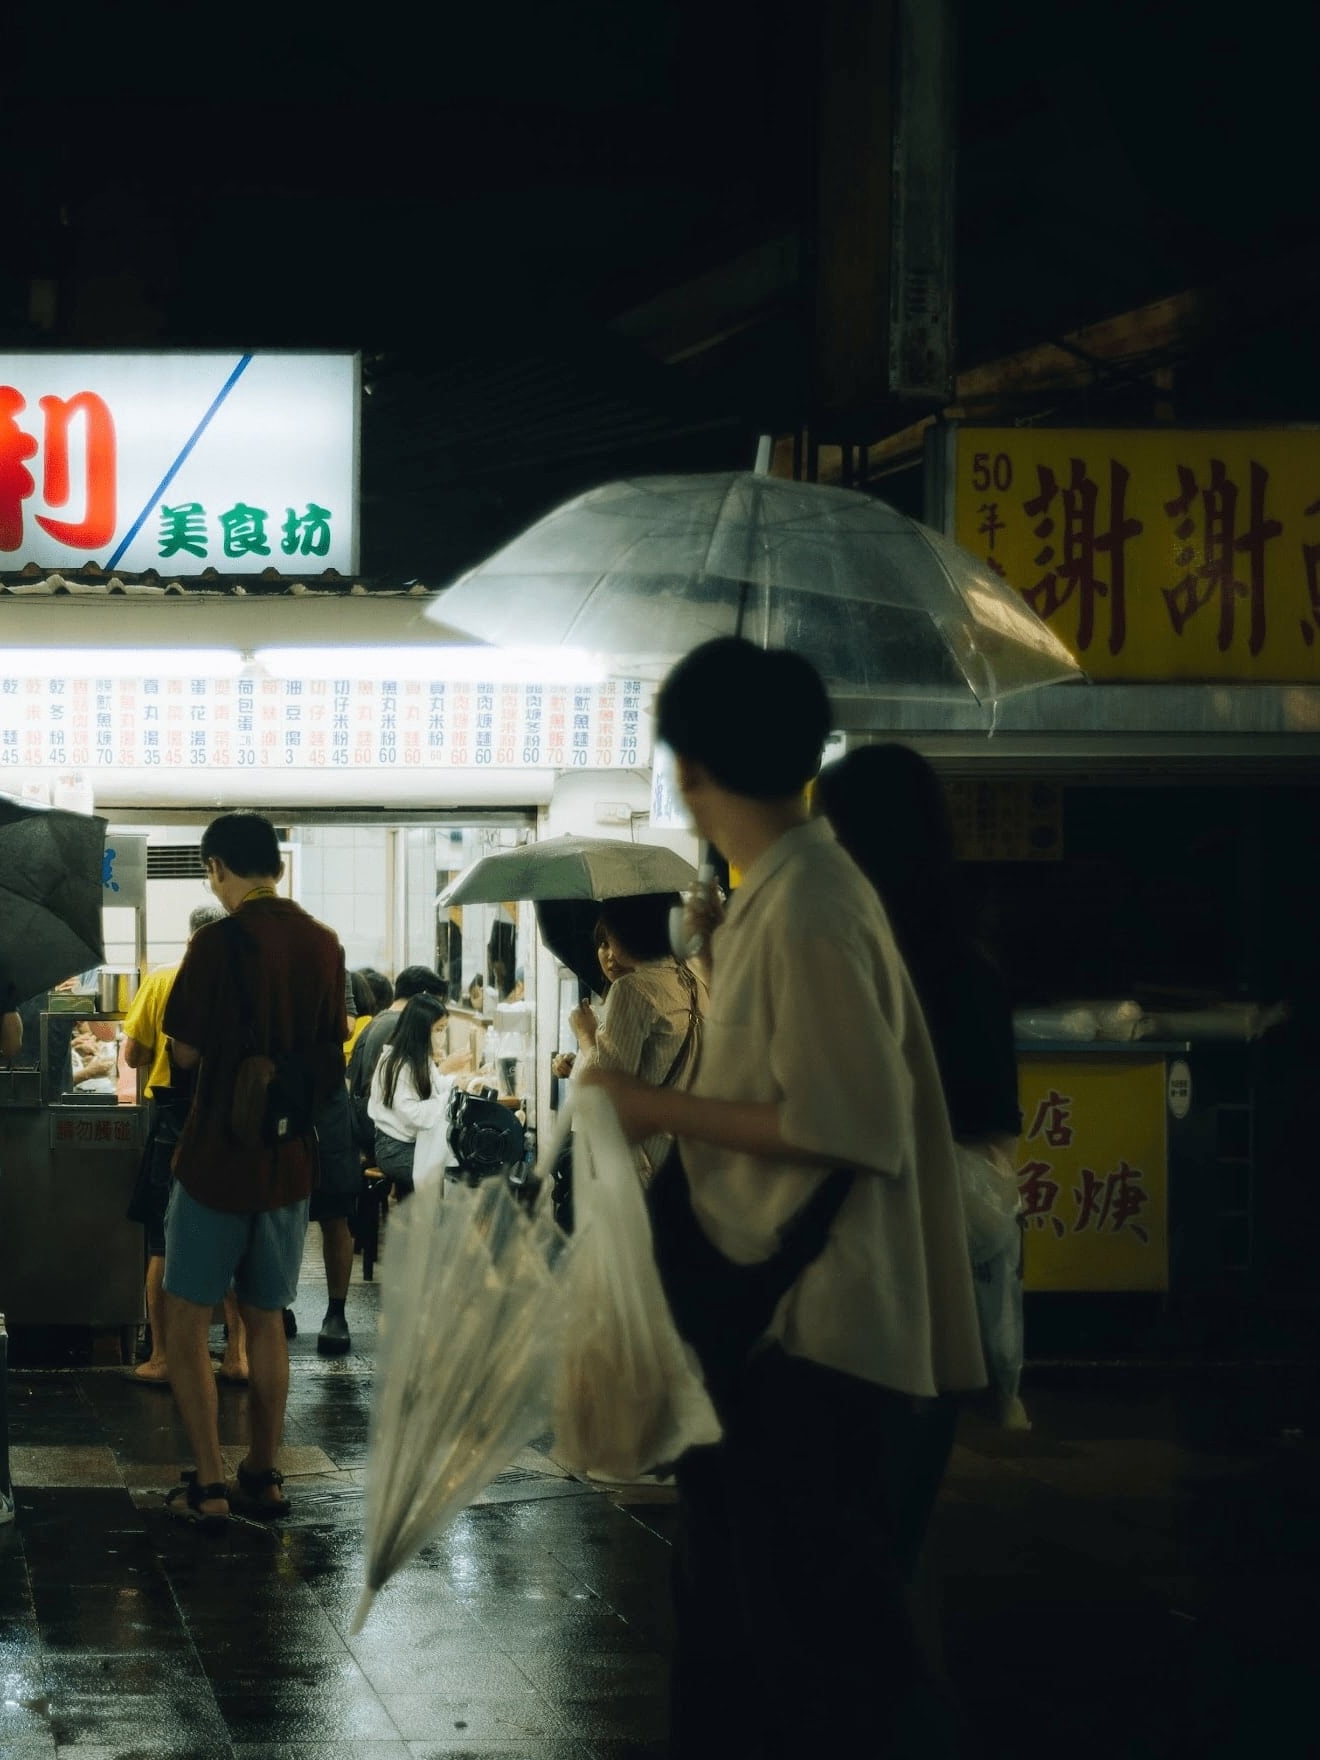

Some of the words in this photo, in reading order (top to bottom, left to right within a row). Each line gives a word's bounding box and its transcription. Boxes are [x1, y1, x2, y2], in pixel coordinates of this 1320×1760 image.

[158, 502, 332, 559] 美食坊
[1021, 457, 1320, 656] 謝謝
[49, 679, 65, 745] 乾冬粉
[1, 749, 19, 764] 45
[49, 748, 66, 764] 45
[96, 748, 113, 764] 70
[144, 750, 161, 765] 35
[190, 749, 206, 765] 35
[237, 749, 255, 765] 30
[332, 749, 349, 765] 45
[379, 748, 397, 763] 60
[475, 748, 492, 764] 60
[523, 748, 539, 763] 60
[547, 748, 564, 764] 70
[572, 750, 587, 765] 70
[596, 750, 612, 765] 70
[620, 750, 636, 765] 70
[1021, 1091, 1071, 1147] 店
